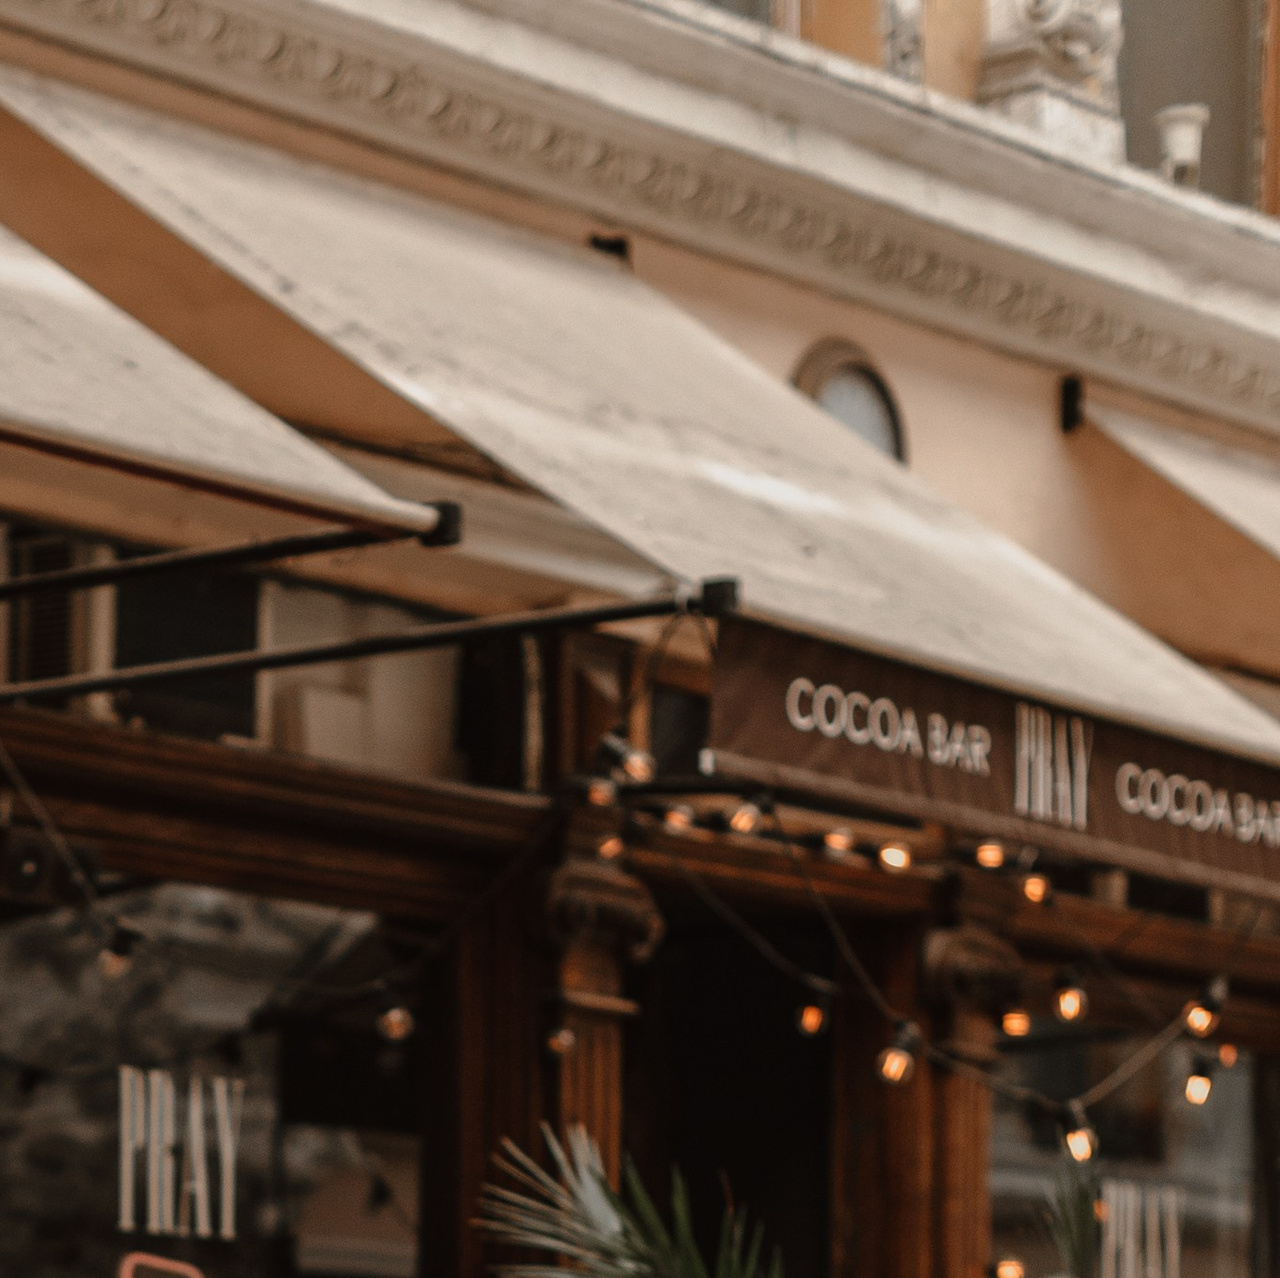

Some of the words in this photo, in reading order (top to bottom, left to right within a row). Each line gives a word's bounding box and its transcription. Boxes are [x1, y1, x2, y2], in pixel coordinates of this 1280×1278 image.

[786, 677, 923, 758] COCOA
[927, 712, 992, 777] BAR
[1115, 763, 1233, 838] COCOA
[119, 1064, 244, 1240] PRAY
